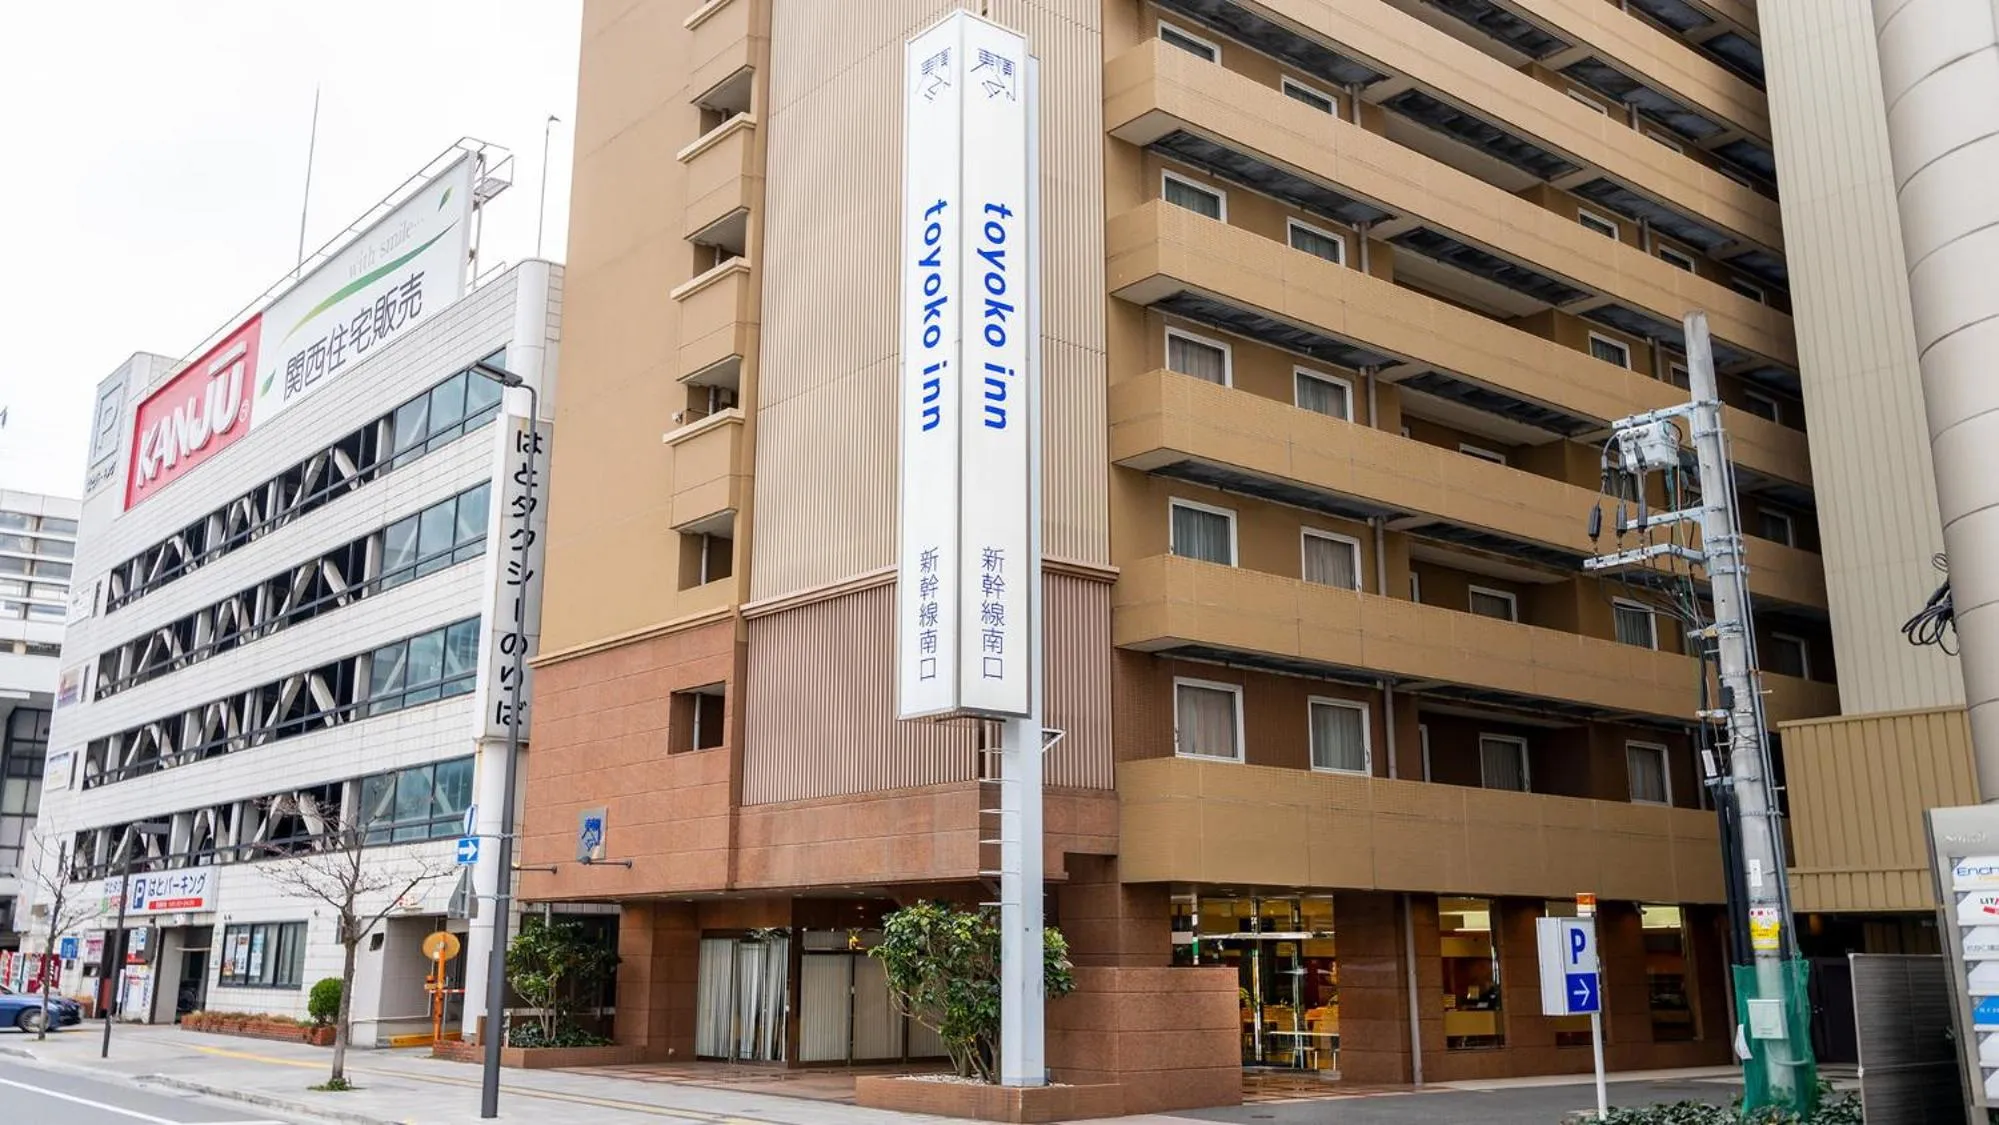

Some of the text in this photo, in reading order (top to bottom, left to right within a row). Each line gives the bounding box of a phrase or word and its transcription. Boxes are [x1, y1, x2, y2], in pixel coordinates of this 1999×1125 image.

[349, 247, 376, 278] with
[918, 199, 948, 432] toyoko inn
[977, 203, 1014, 430] toyoko inn
[285, 272, 424, 400] 関西住宅販売
[919, 546, 939, 681] 新幹線南口
[981, 546, 1006, 680] 新幹線南口
[148, 873, 206, 896] はとパーキング
[1570, 928, 1586, 964] P
